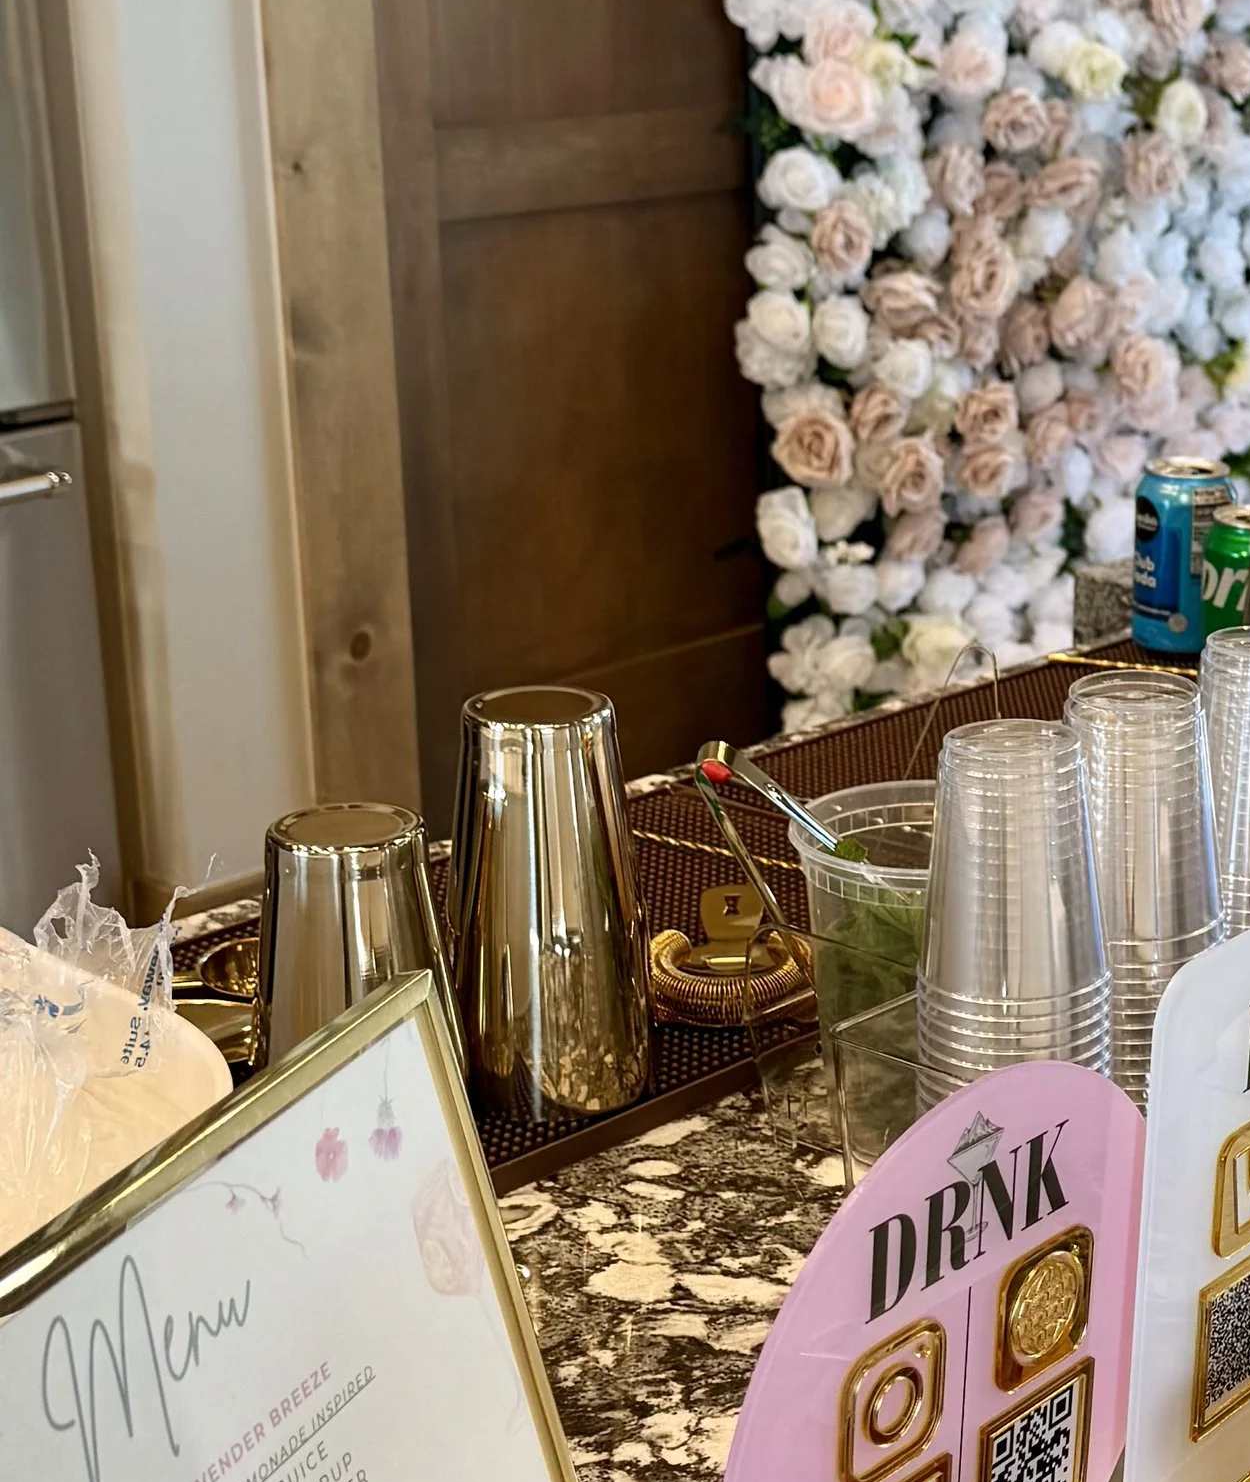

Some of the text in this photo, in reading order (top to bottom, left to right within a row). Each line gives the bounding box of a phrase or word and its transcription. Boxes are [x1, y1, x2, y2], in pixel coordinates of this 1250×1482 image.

[865, 1119, 1069, 1324] DRNK
[269, 1361, 333, 1428] BREEZE
[311, 1365, 376, 1432] INSPIRED
